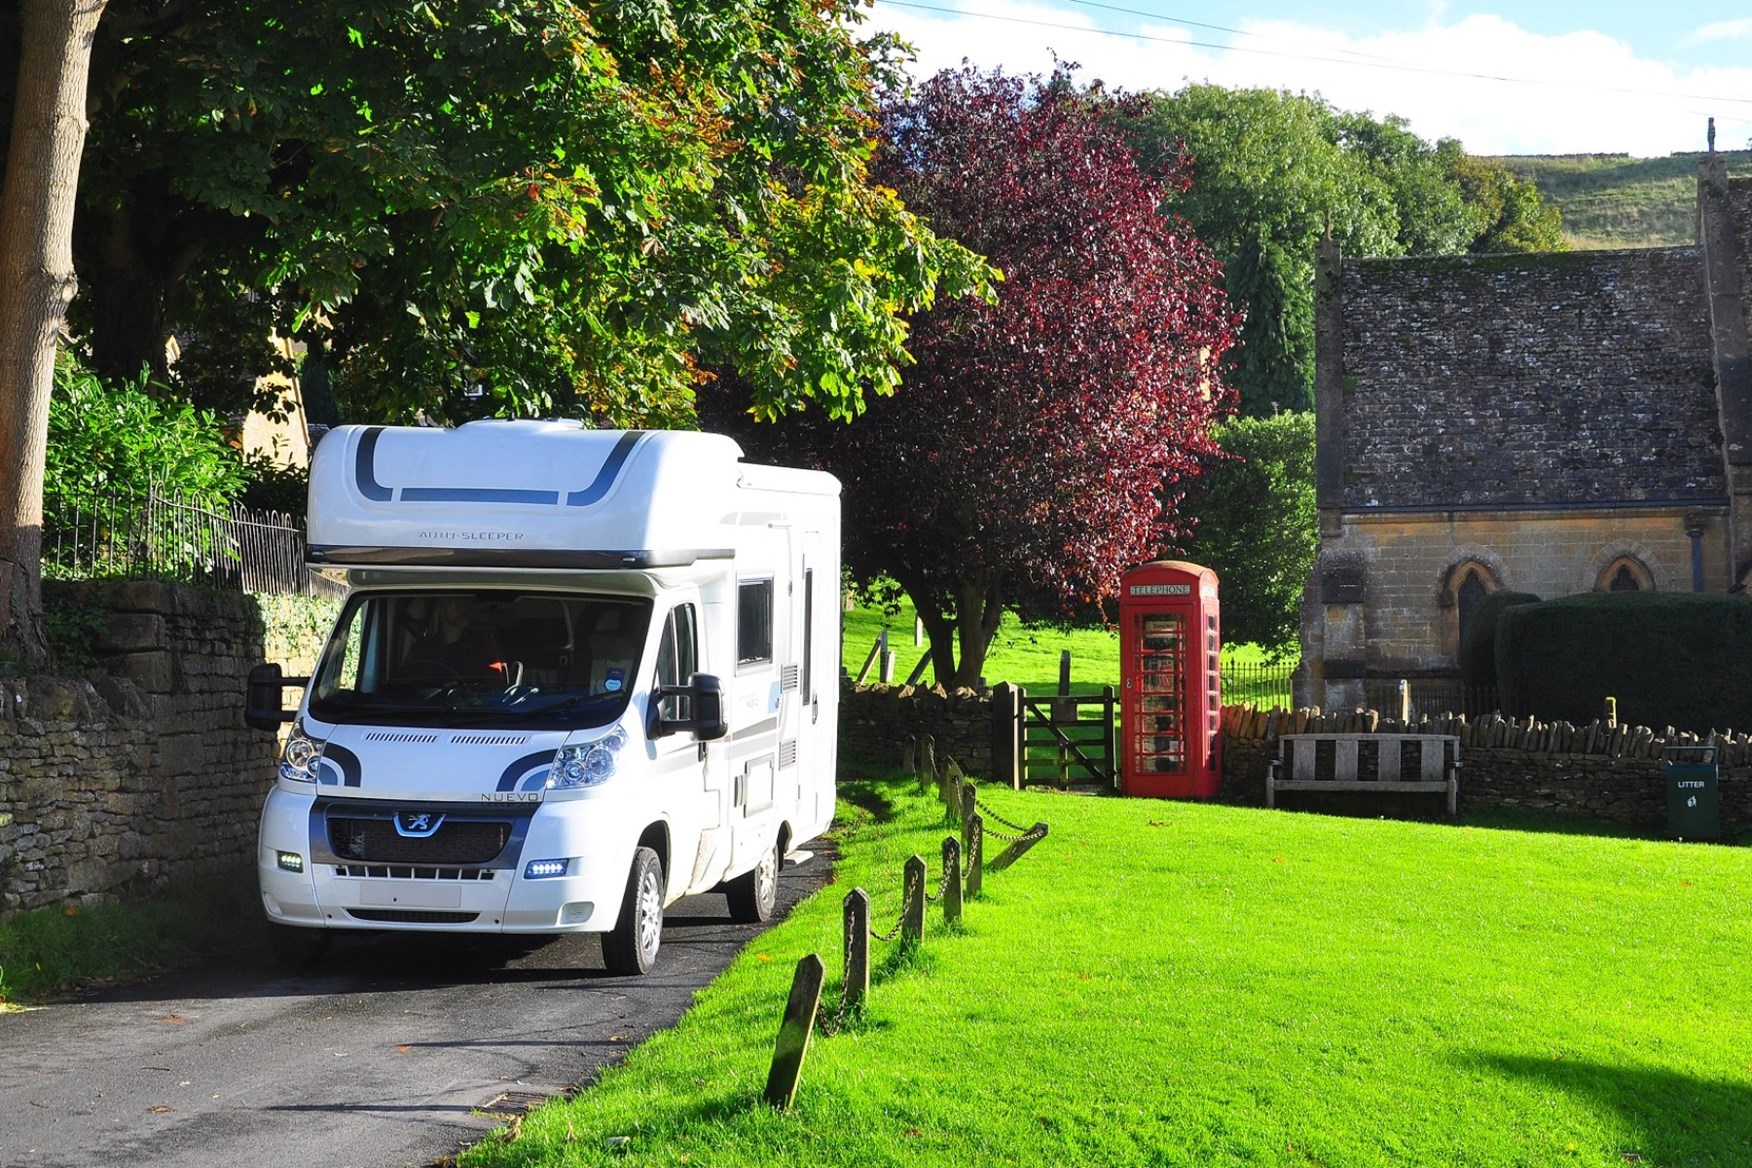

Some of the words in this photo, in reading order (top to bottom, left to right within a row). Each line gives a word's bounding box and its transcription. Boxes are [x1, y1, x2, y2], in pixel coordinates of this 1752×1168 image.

[1132, 585, 1189, 595] TELEPHONE
[1677, 780, 1705, 789] LITTER
[481, 792, 540, 802] NUEVO
